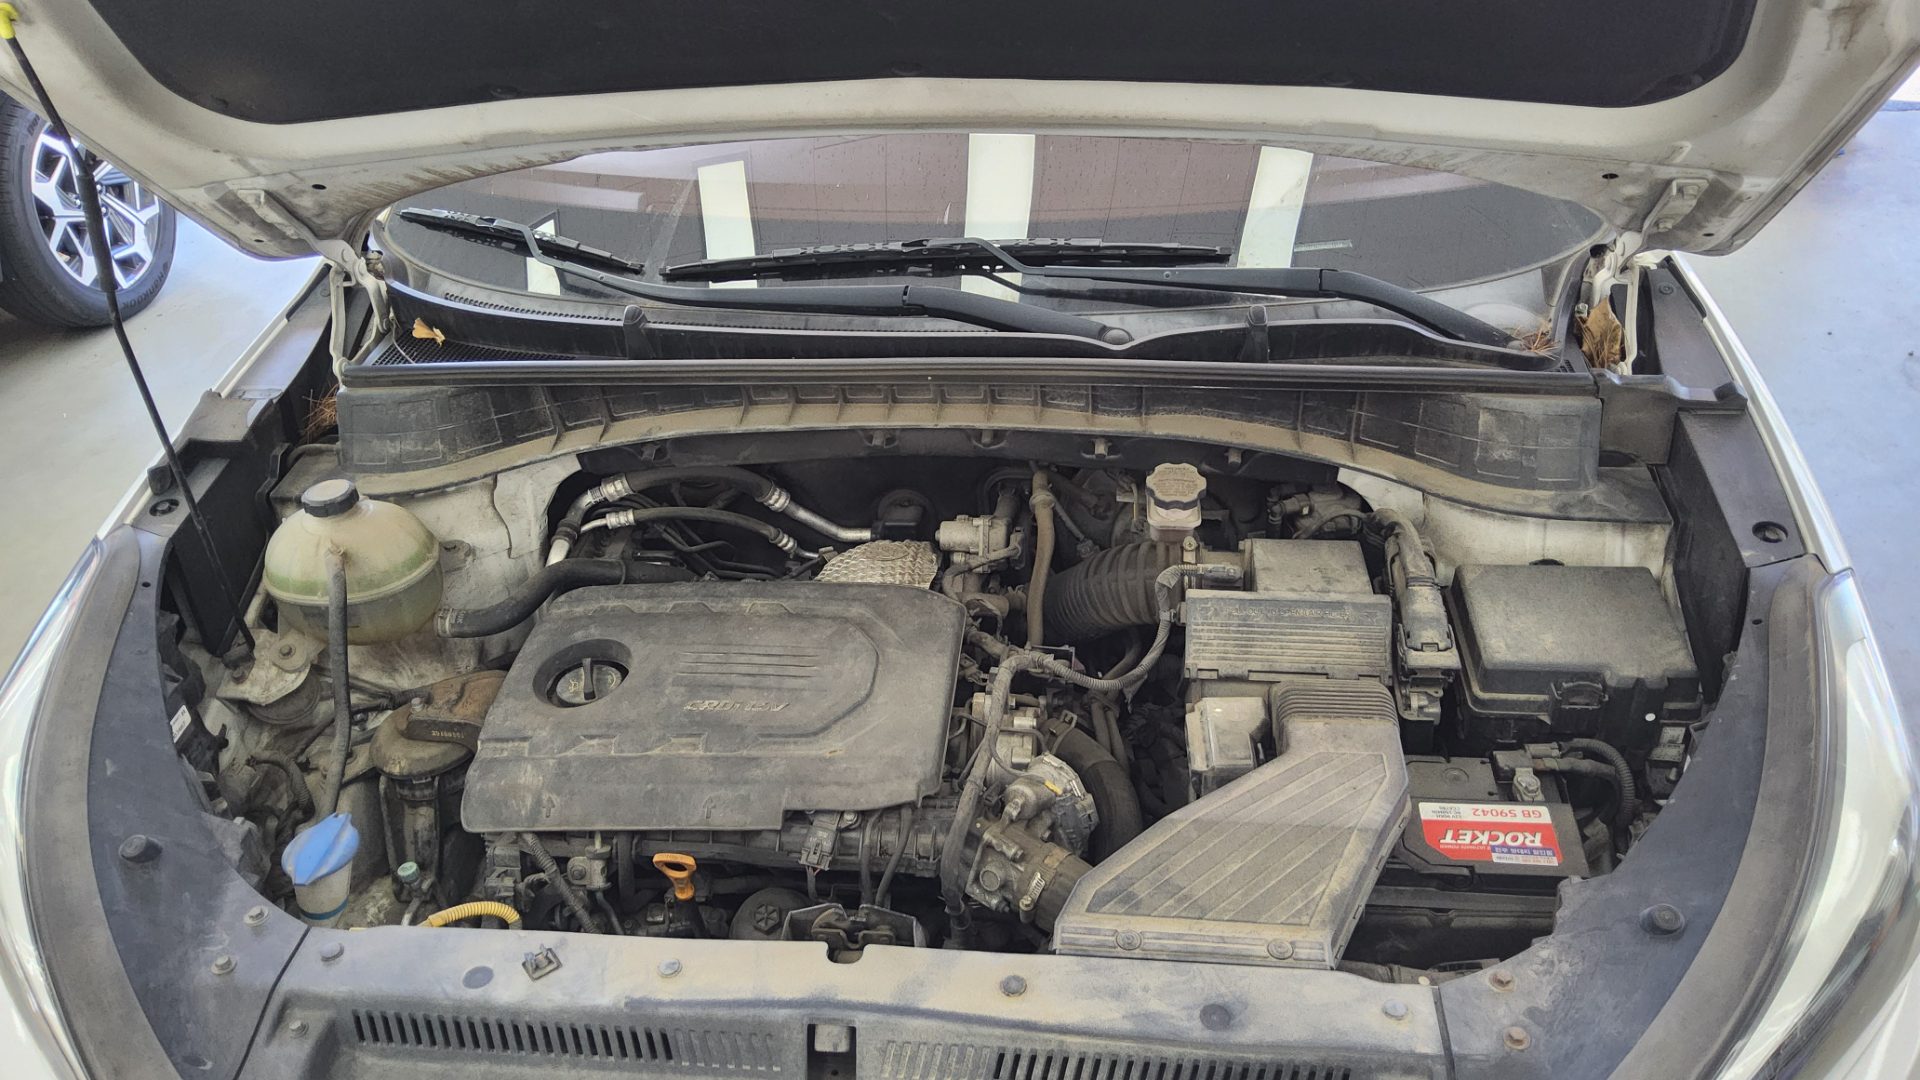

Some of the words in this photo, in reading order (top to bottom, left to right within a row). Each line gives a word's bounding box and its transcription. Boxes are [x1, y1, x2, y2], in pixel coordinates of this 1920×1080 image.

[1472, 807, 1517, 817] 59042
[1522, 809, 1542, 818] GB
[1439, 829, 1543, 847] ROCKET
